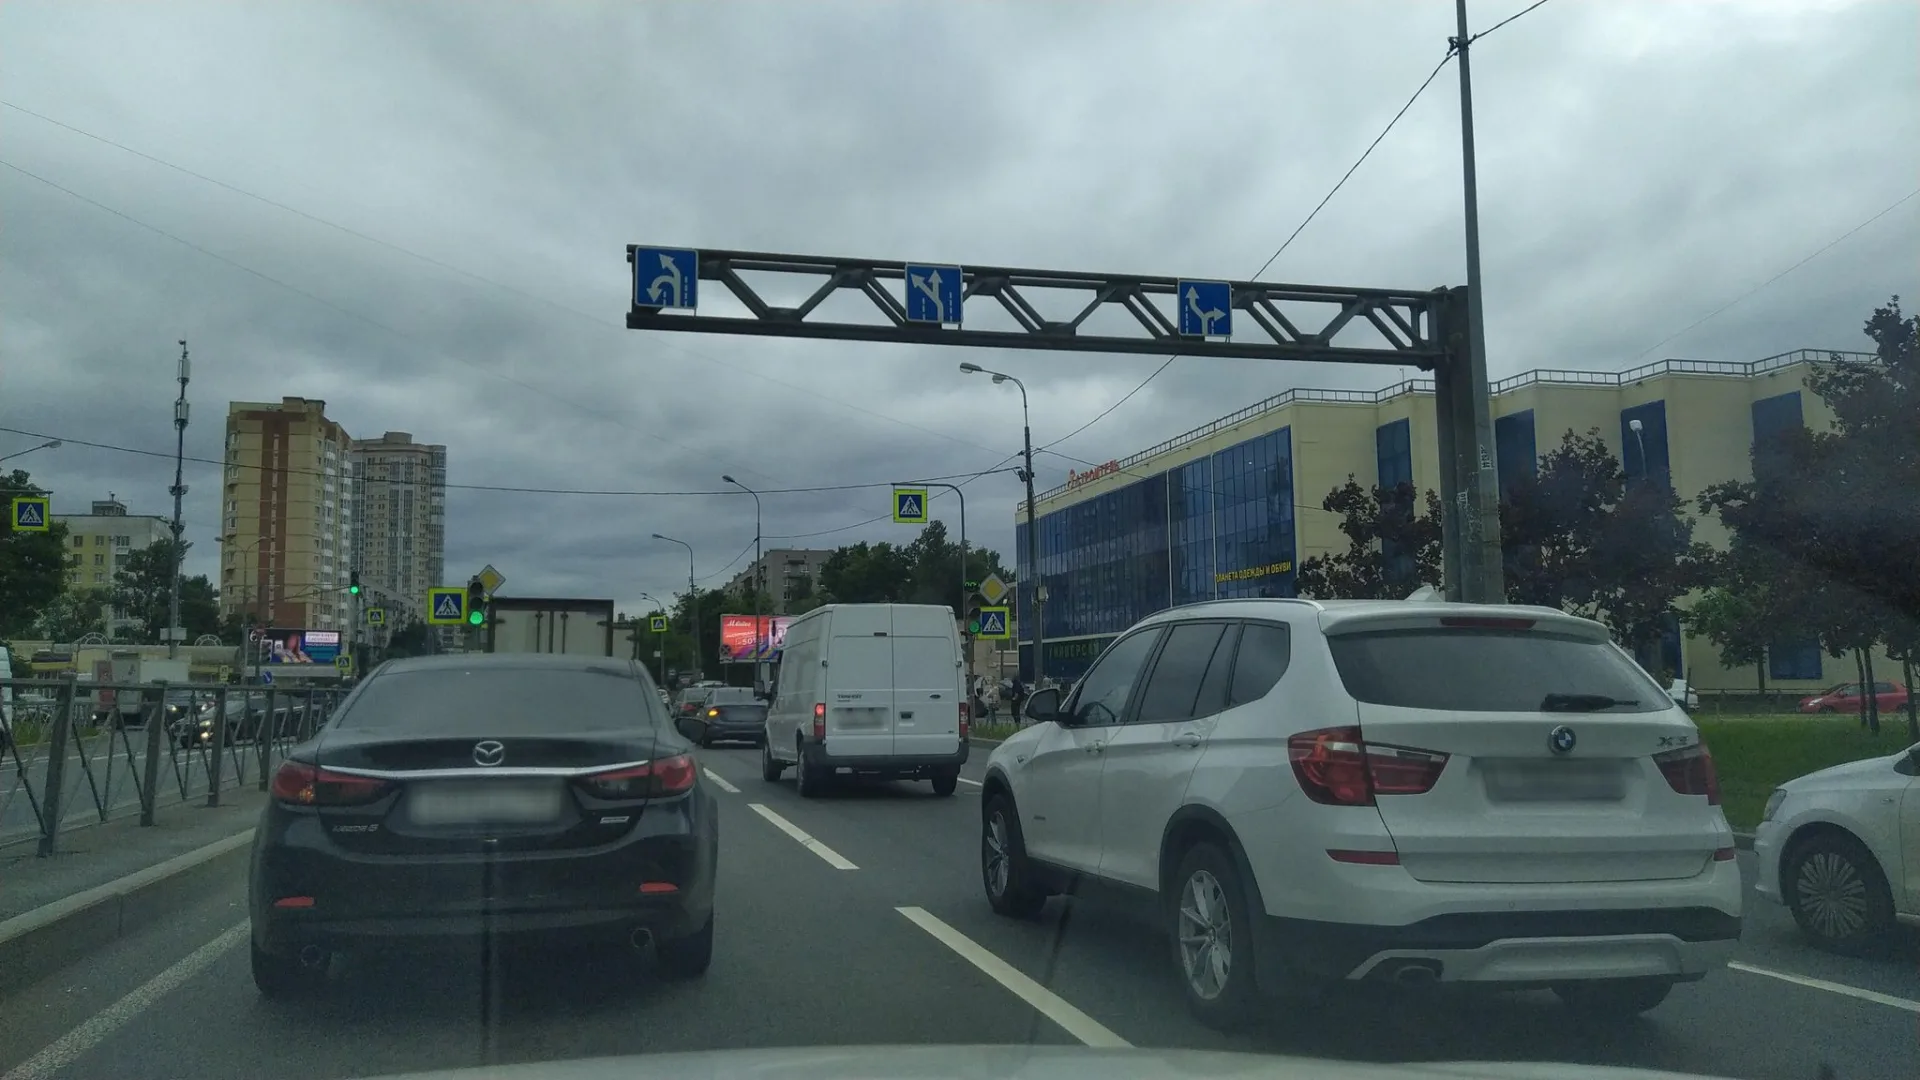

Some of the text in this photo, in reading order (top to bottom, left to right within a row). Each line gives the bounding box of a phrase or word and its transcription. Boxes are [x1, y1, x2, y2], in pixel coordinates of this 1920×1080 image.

[1239, 567, 1265, 580] ОДЕЖДЫ
[1271, 561, 1291, 574] ОБУВИ
[1656, 735, 1688, 747] X3
